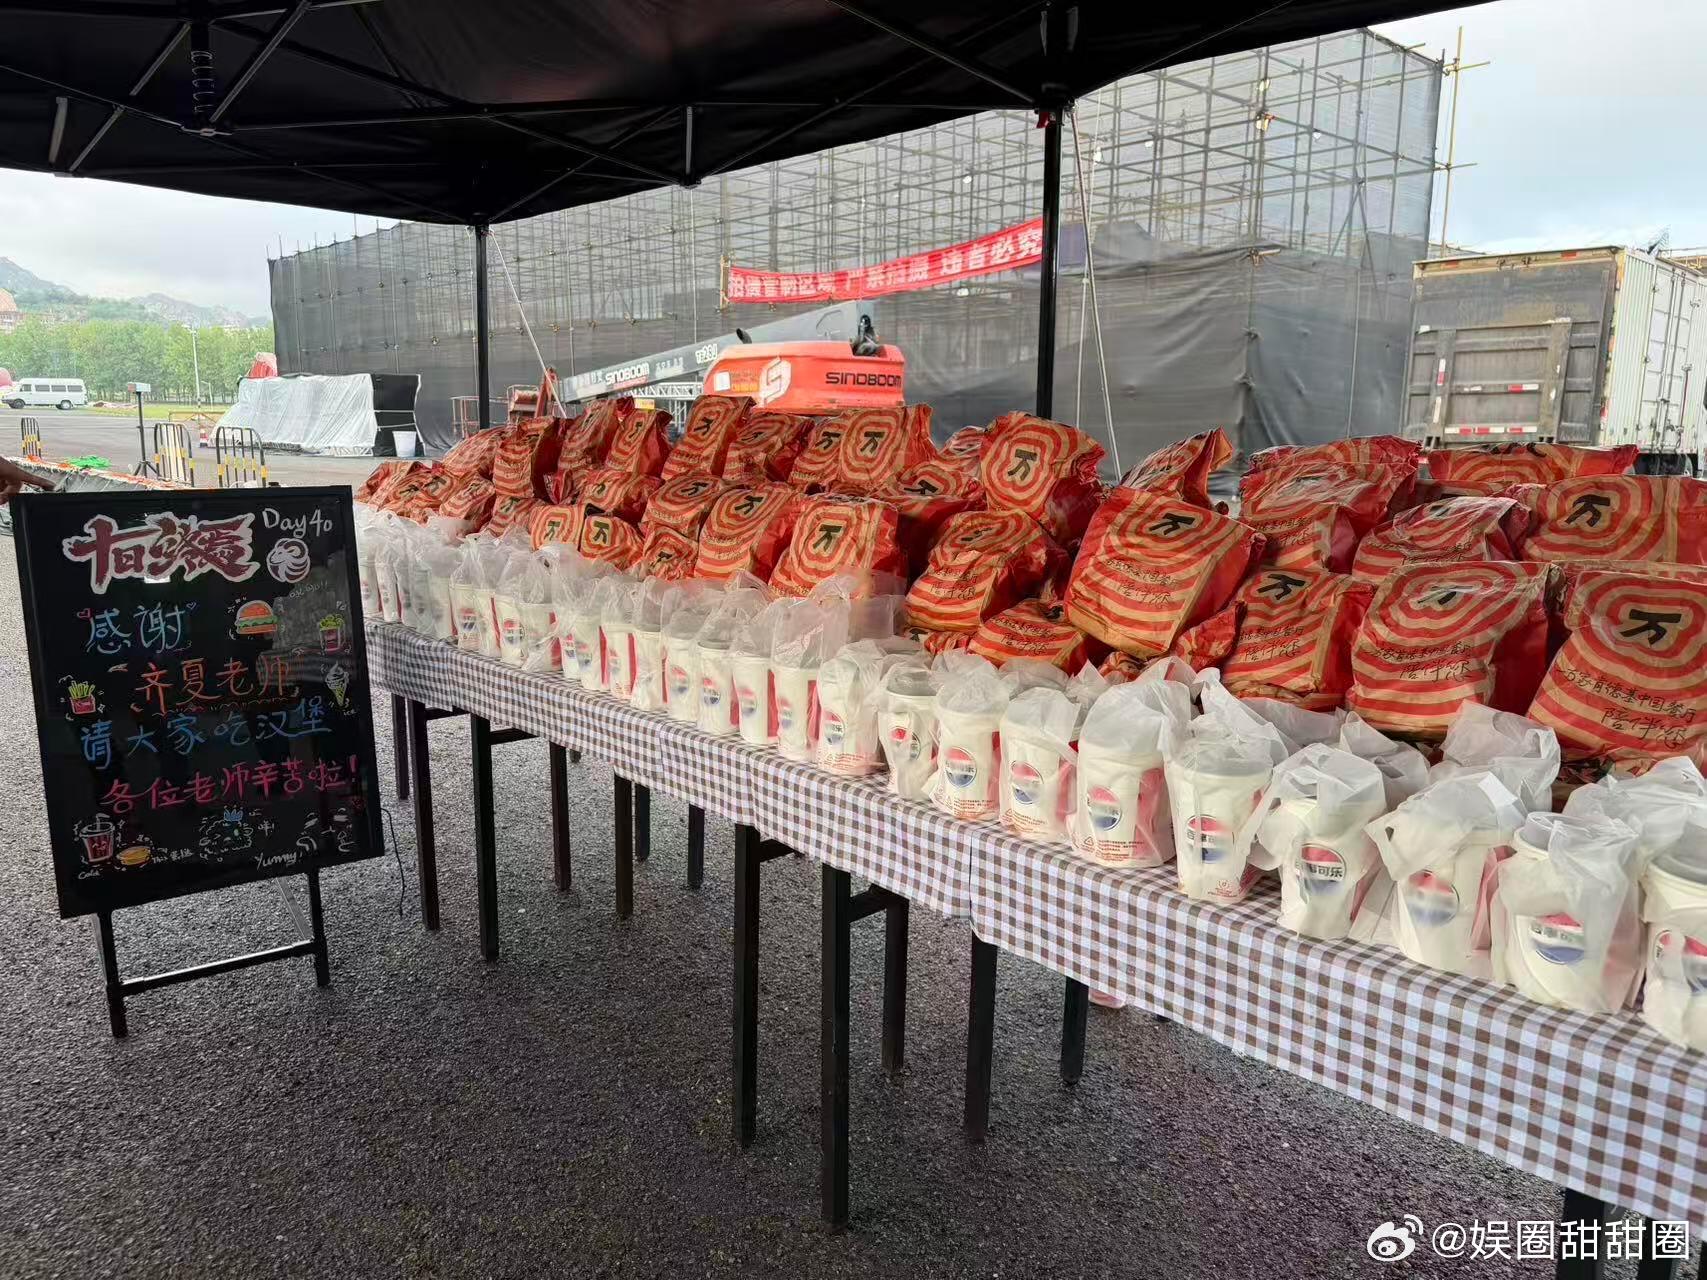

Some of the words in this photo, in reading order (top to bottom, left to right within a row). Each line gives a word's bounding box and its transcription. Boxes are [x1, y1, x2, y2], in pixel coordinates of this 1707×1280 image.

[825, 371, 902, 388] SINOBOOM
[262, 508, 307, 539] Day
[87, 605, 186, 653] 感谢
[136, 658, 290, 716] 齐夏老师
[81, 696, 331, 769] 请大家吃汉堡
